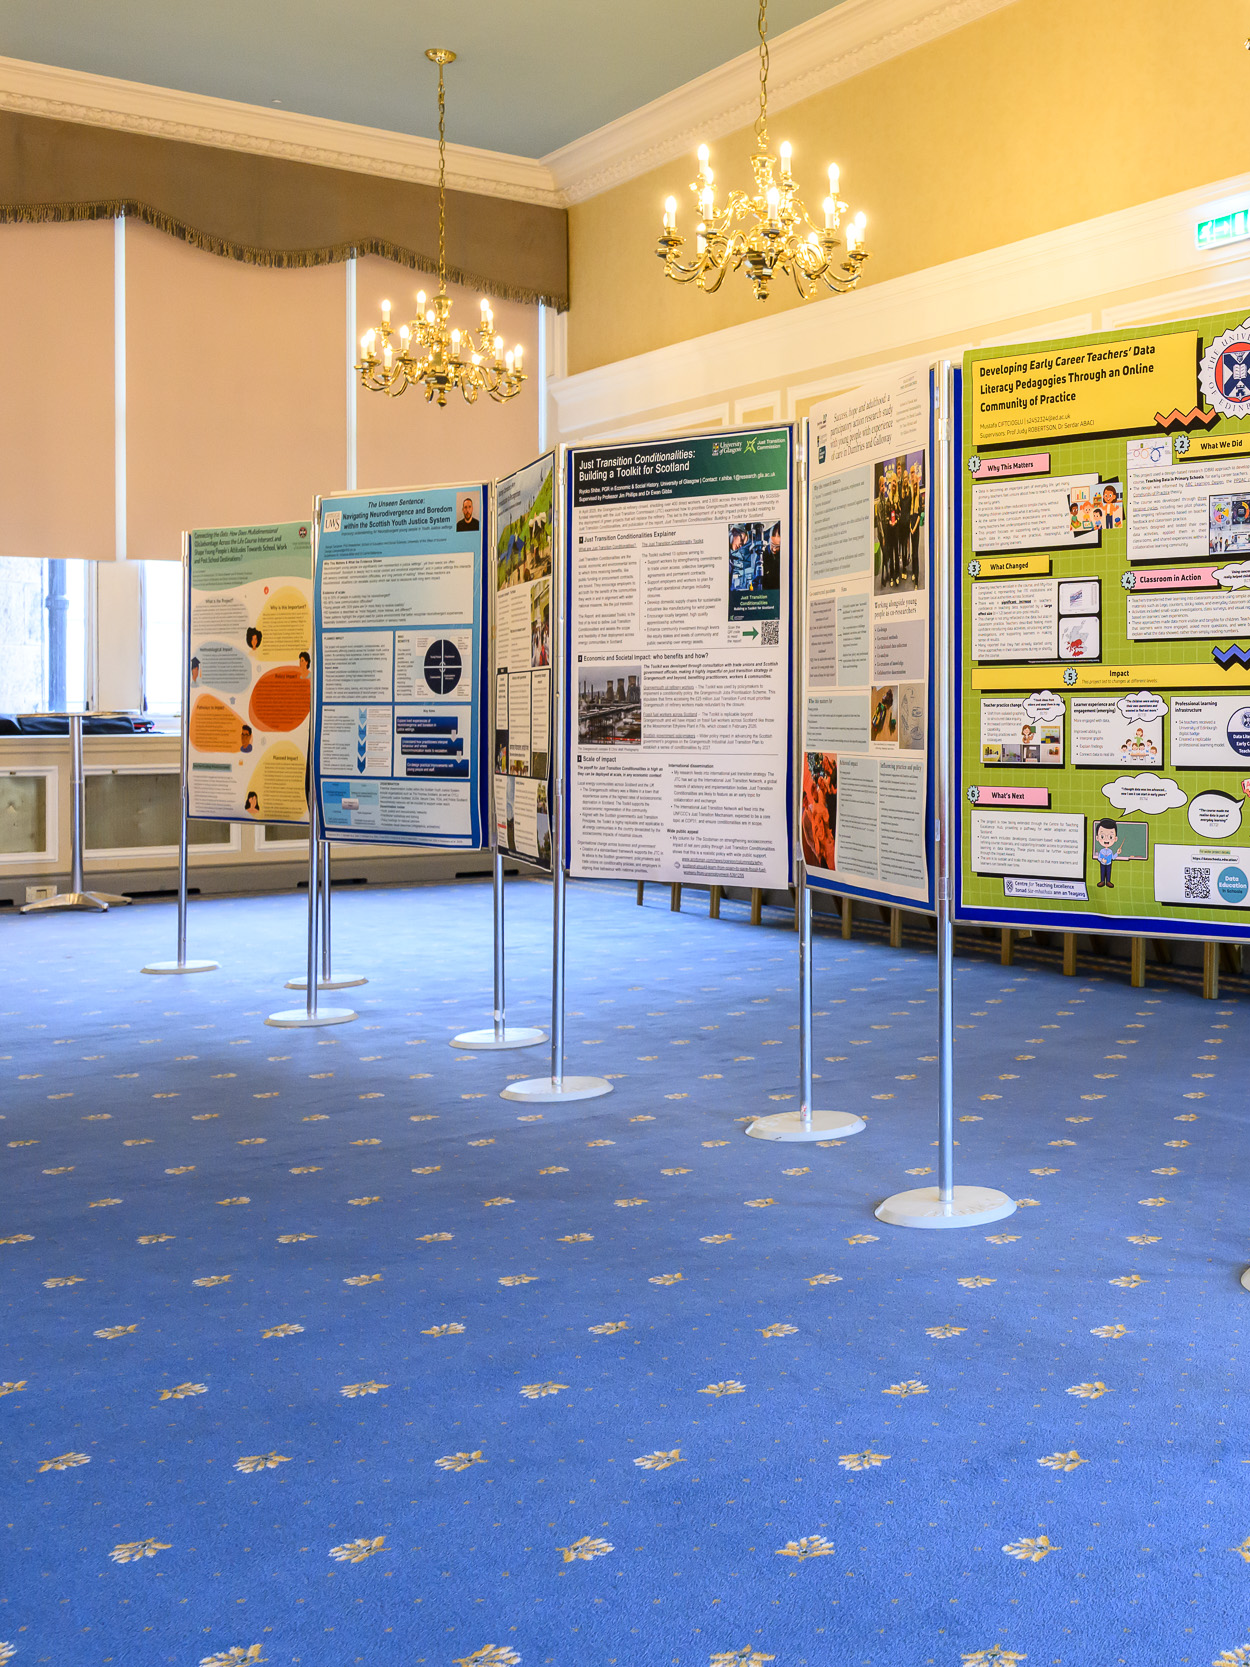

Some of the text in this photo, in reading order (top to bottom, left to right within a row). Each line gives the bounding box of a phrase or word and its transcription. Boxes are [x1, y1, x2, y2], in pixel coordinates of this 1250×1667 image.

[980, 363, 1027, 377] Developing
[1029, 359, 1053, 371] Early
[1055, 356, 1085, 368] Career
[1133, 345, 1156, 357] Data
[1208, 350, 1218, 370] THE
[980, 364, 1154, 395] Literacy Pedagogies Through an Online
[980, 392, 1076, 413] Community of Practice
[1200, 441, 1218, 450] What
[1231, 439, 1243, 447] Did
[579, 450, 696, 470] Just Transition Conditionalities:
[579, 471, 607, 481] Building
[617, 466, 641, 478] Toolkit
[642, 466, 653, 475] for
[655, 462, 690, 474] Scotland
[988, 461, 1034, 472] Why This Matters
[343, 512, 368, 521] Navigating
[369, 510, 414, 518] Neurodivergence
[426, 506, 453, 514] Boredom
[326, 519, 340, 530] UWS
[368, 520, 390, 528] Scottish
[990, 560, 1029, 570] What Changed
[1173, 574, 1180, 582] in
[1180, 573, 1202, 581] Action
[1109, 670, 1130, 678] Impact
[1011, 792, 1025, 800] Next
